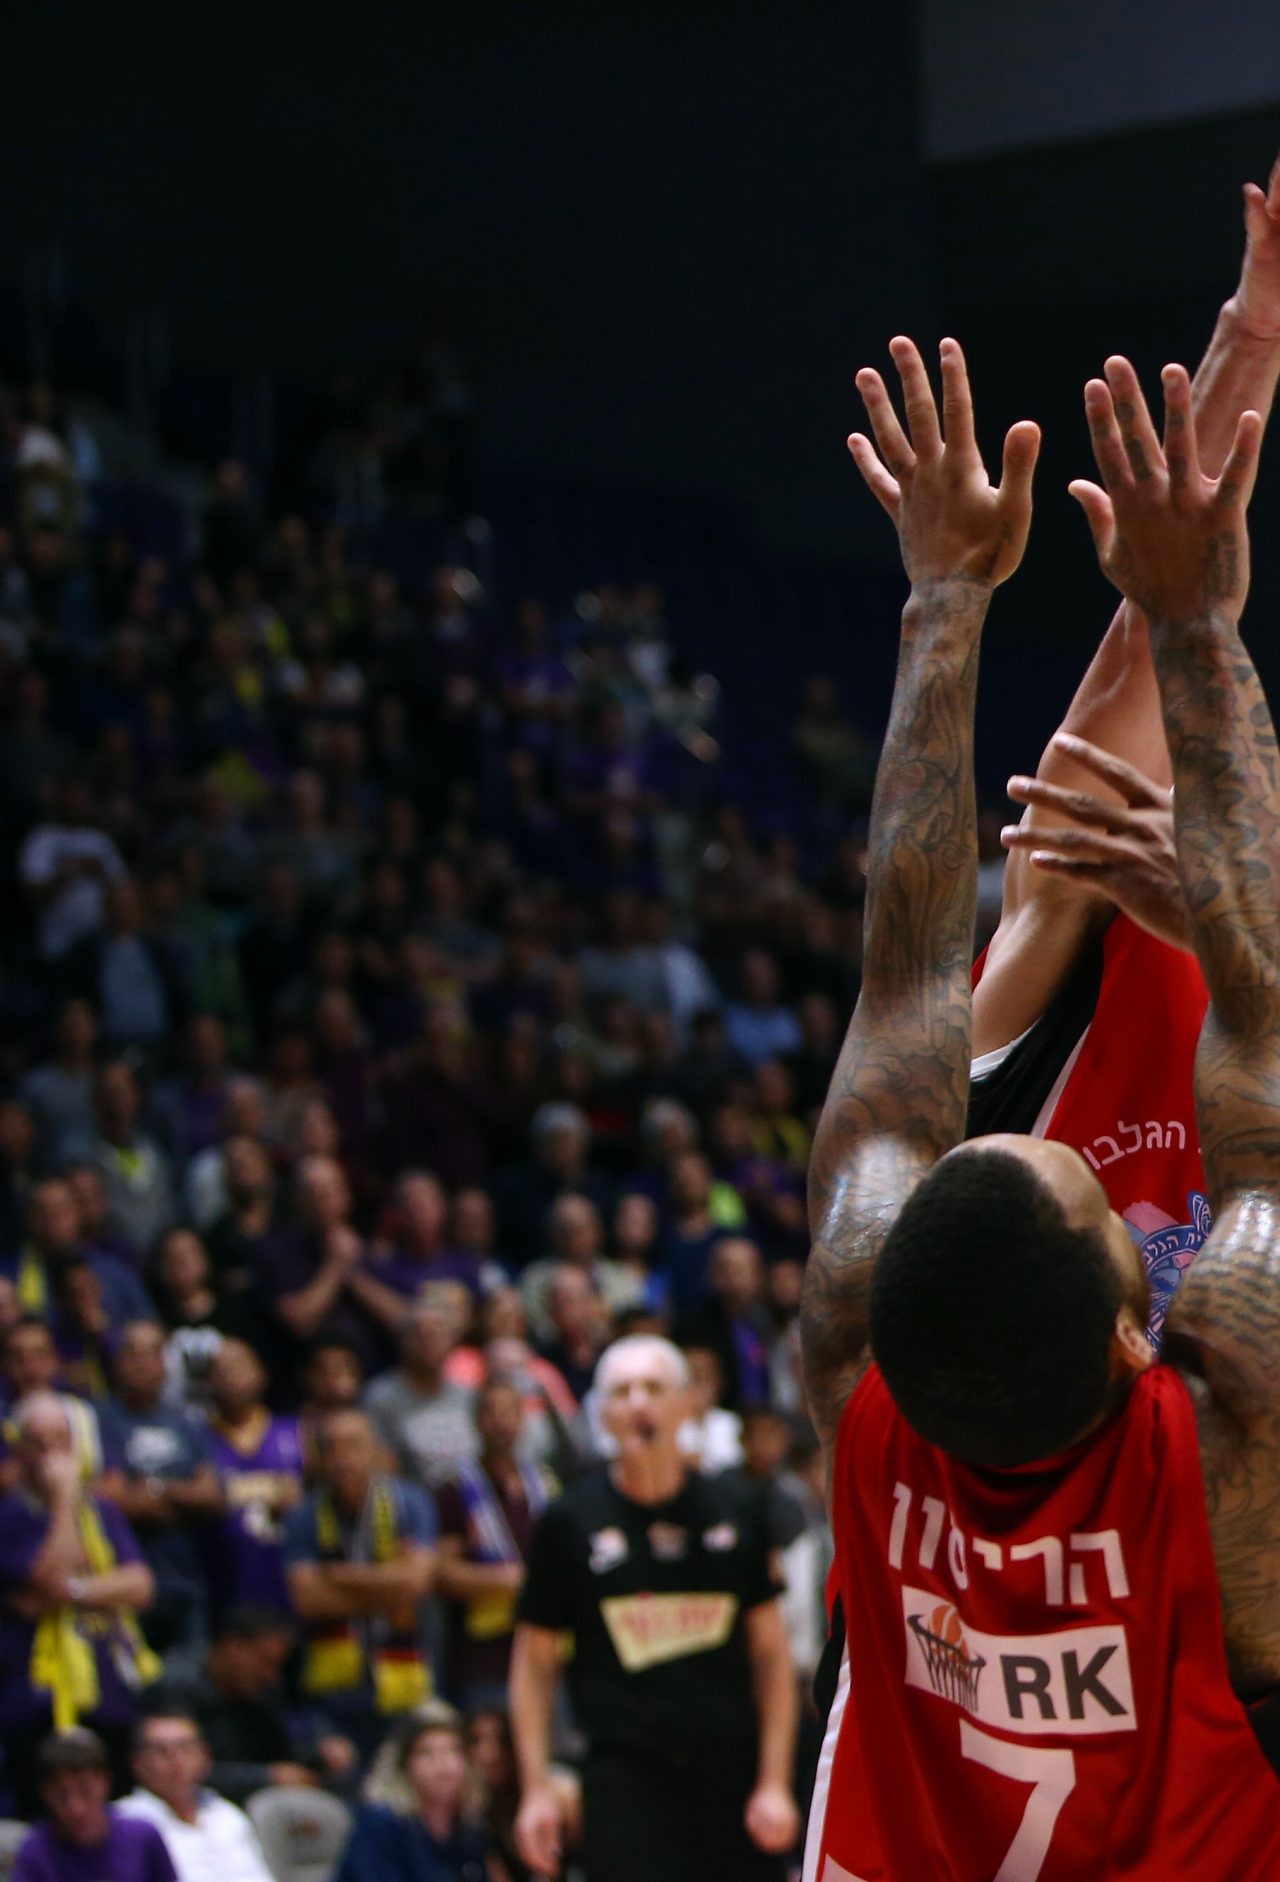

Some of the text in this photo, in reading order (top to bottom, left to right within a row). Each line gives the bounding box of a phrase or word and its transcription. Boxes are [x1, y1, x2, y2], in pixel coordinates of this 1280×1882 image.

[1082, 1120, 1186, 1170] הגלבו
[888, 1481, 1130, 1606] הריסון
[1000, 1645, 1128, 1720] RK
[959, 1718, 1076, 1882] 7
